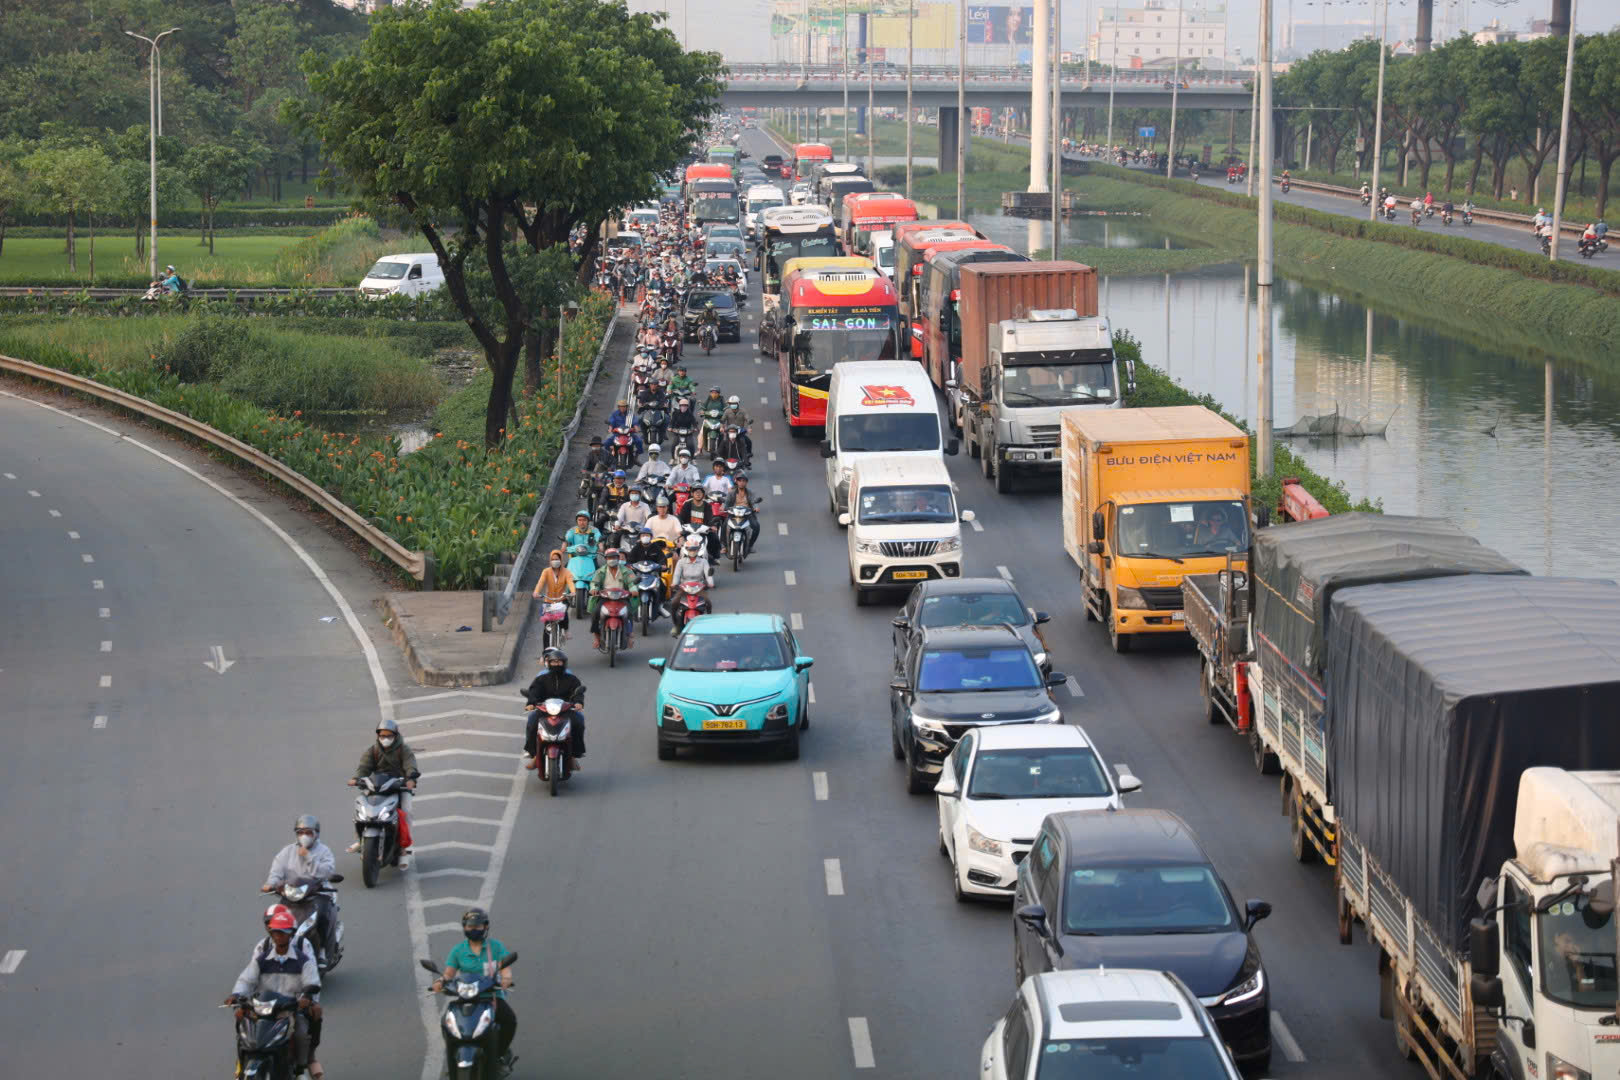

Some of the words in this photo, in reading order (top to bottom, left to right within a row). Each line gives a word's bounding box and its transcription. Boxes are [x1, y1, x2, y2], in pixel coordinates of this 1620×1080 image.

[812, 318, 838, 328] SAI
[844, 318, 876, 328] GON
[1106, 456, 1134, 466] BƯU
[1174, 452, 1202, 464] VIỆT
[1206, 453, 1236, 462] NAM
